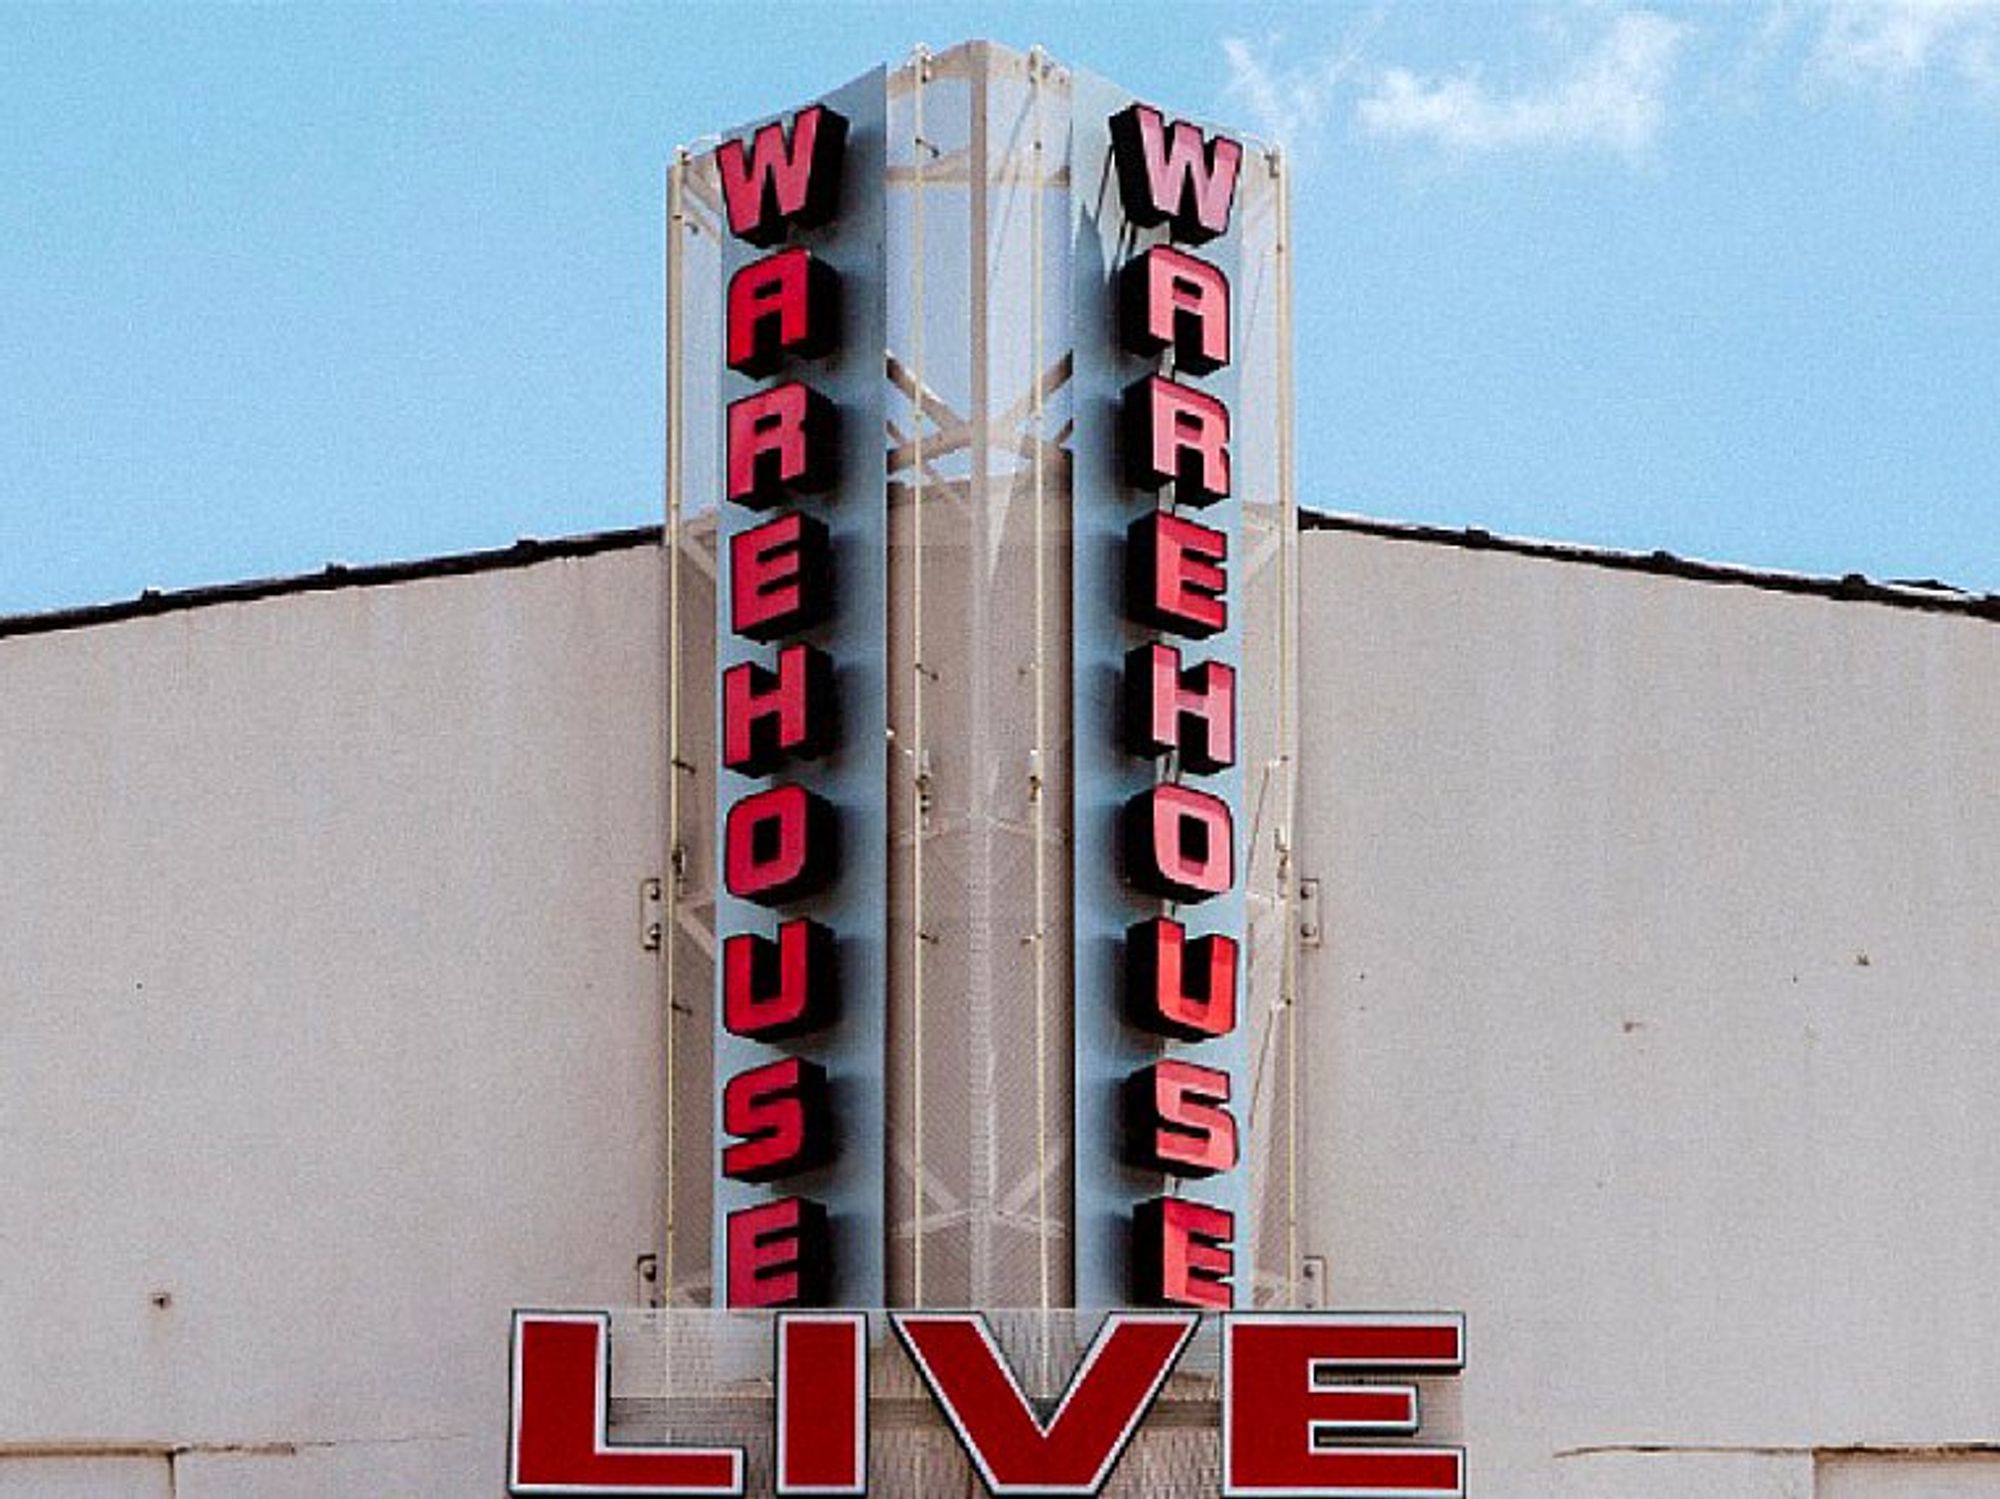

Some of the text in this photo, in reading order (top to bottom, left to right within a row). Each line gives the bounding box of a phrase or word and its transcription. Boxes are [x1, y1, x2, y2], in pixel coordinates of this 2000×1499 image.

[715, 103, 836, 1309] WAREHOUSE
[1124, 103, 1243, 1309] WAREHOUSE
[511, 1310, 1465, 1496] LIVE
